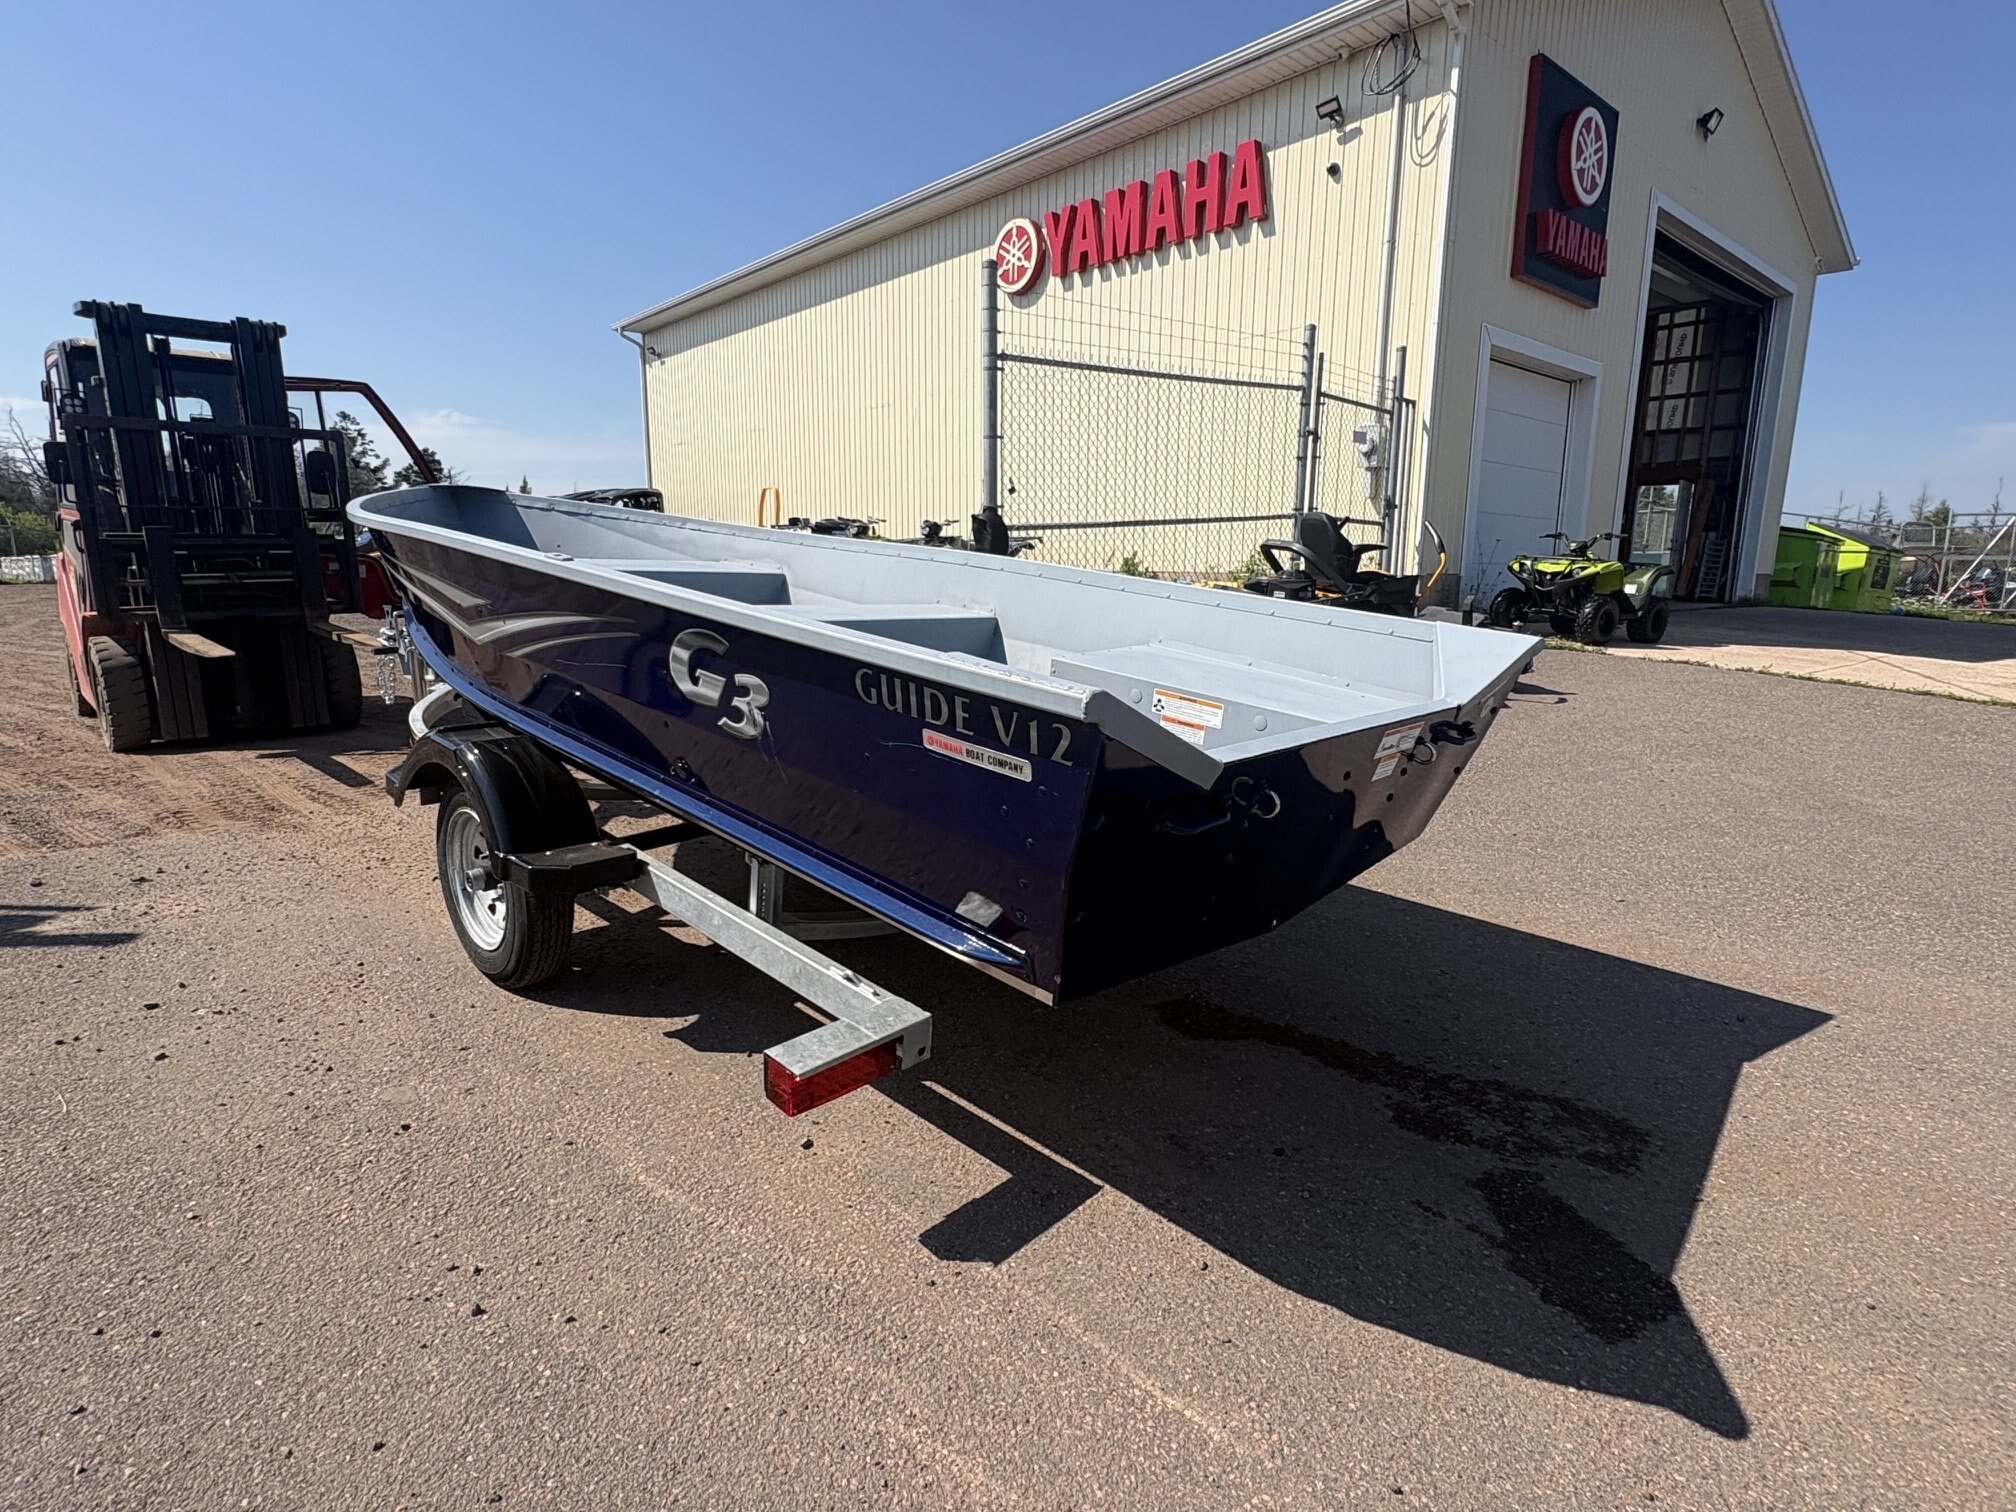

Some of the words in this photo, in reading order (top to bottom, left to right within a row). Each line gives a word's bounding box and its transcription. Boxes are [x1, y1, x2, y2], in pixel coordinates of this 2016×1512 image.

[1044, 138, 1267, 277] YAMAHA
[1545, 208, 1608, 276] YAMAHA
[669, 628, 770, 739] G3
[855, 668, 975, 736] GUIDE
[990, 705, 1074, 767] V12
[934, 739, 964, 757] YAMAHA
[965, 748, 985, 763] BOAT
[987, 755, 1024, 775] COMPANY
